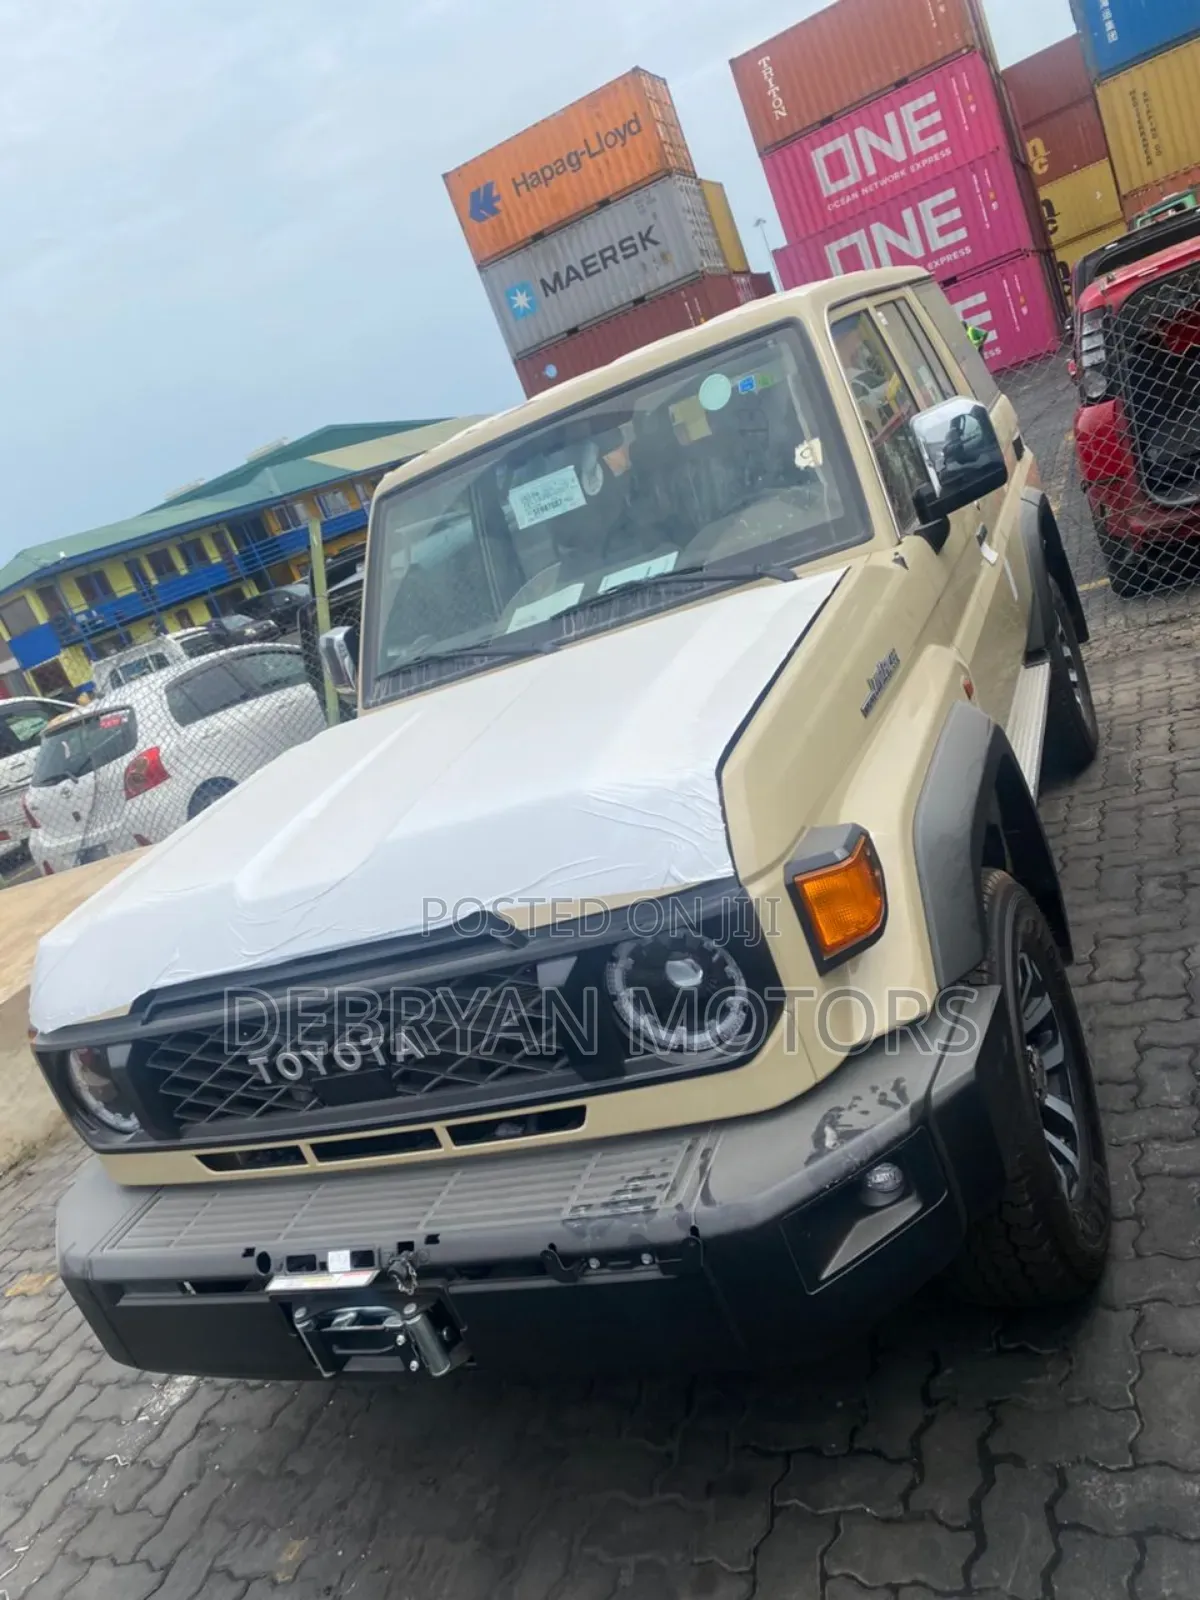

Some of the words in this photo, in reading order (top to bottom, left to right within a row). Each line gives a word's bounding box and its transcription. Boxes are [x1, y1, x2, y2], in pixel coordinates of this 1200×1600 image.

[758, 55, 788, 120] TRITON
[511, 112, 643, 197] Hapag-Lloyd
[810, 91, 948, 198] ONE
[827, 191, 859, 211] OCEAN
[861, 168, 907, 196] NETWORK
[909, 147, 953, 173] EXPRESS
[539, 224, 661, 298] MAERSK
[824, 187, 968, 277] ONE
[927, 245, 972, 271] EXPRESS
[247, 1031, 425, 1085] TOYOTA
